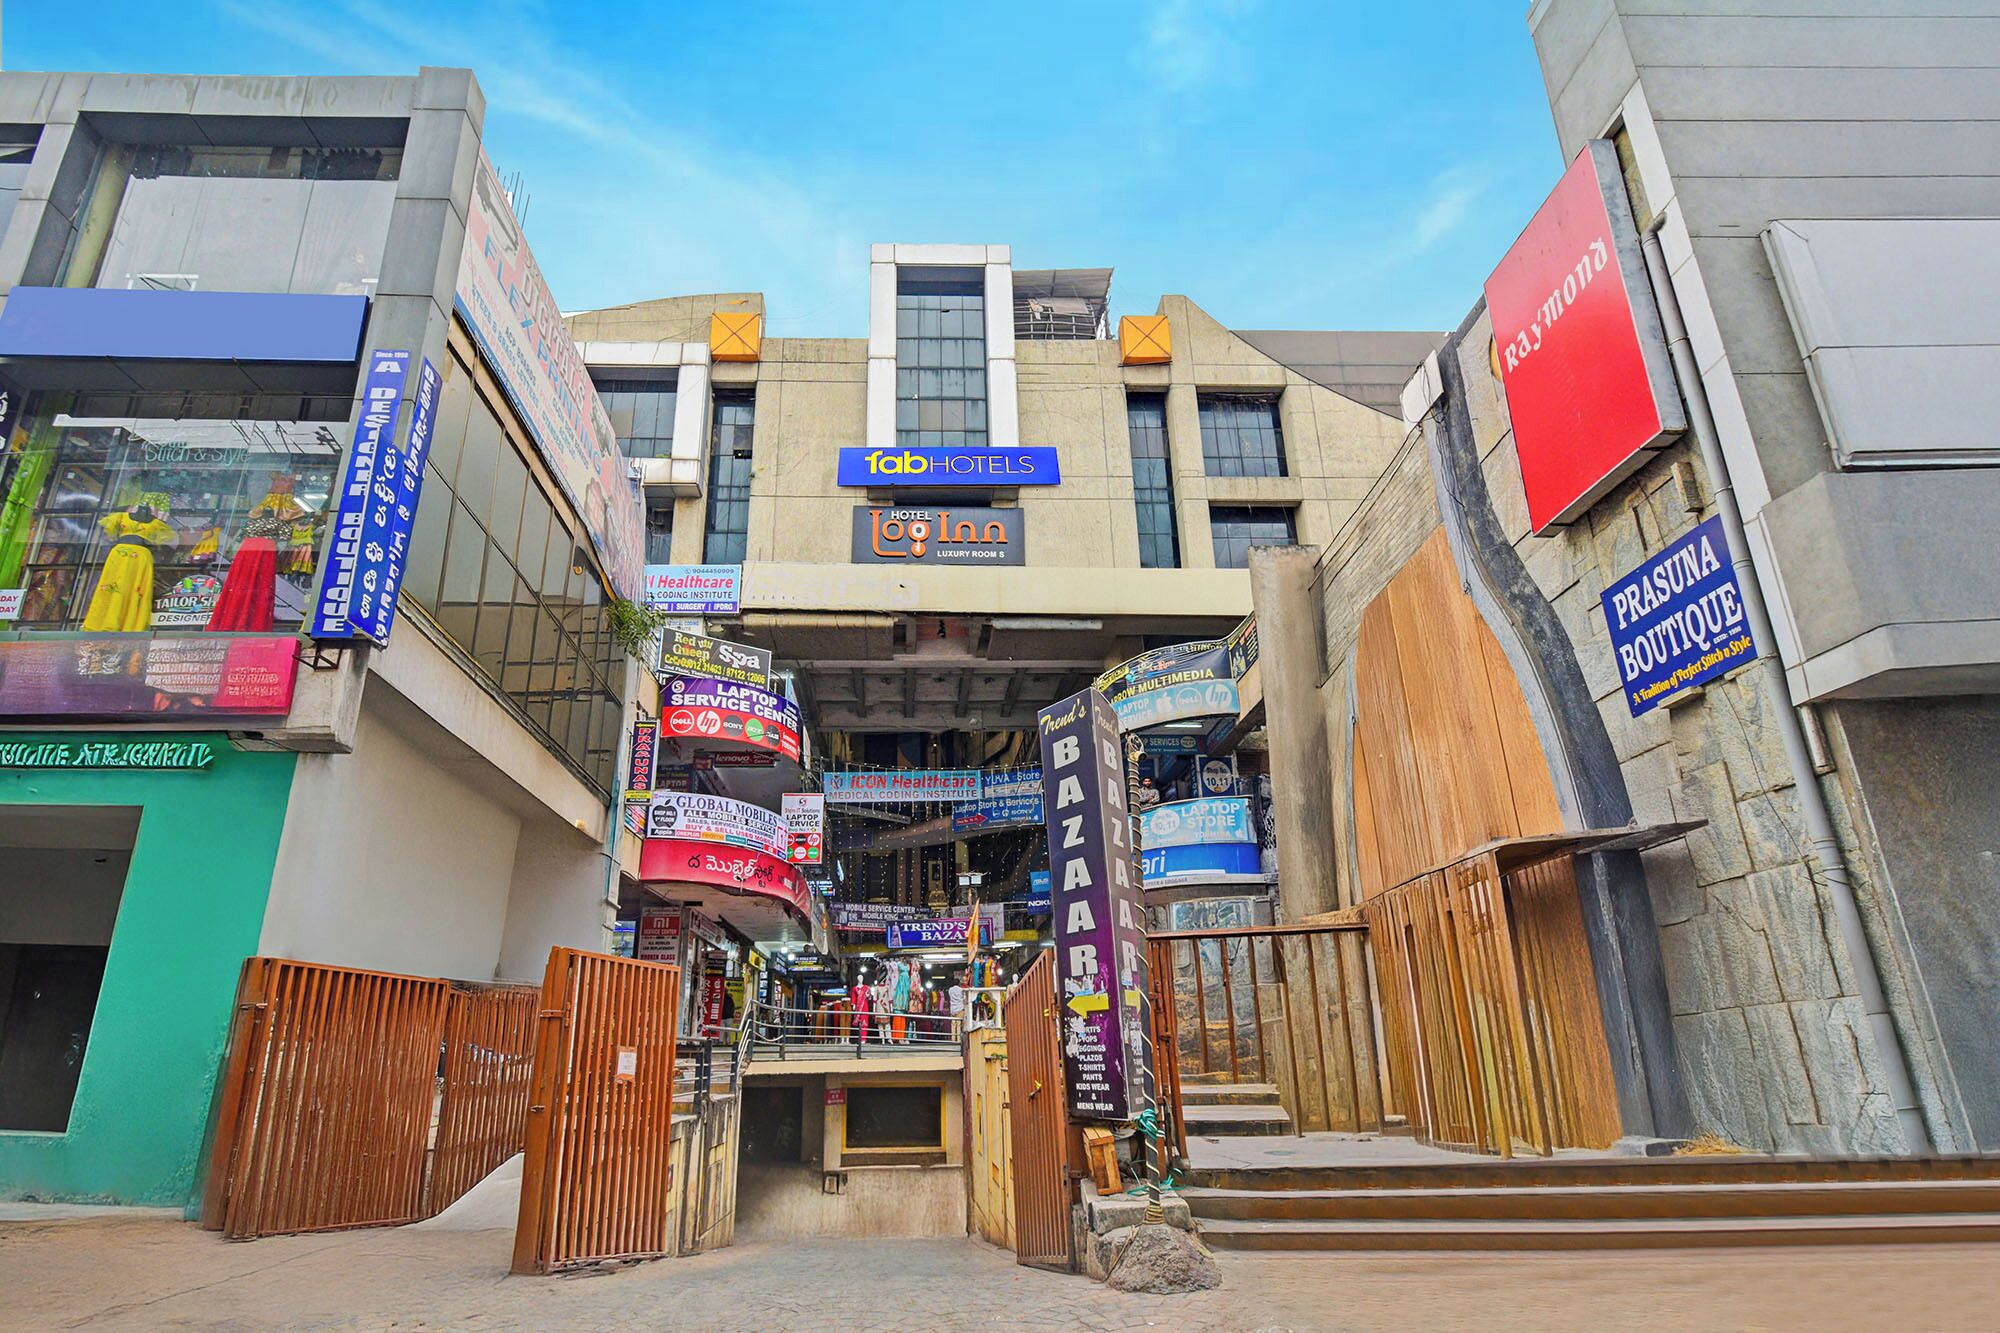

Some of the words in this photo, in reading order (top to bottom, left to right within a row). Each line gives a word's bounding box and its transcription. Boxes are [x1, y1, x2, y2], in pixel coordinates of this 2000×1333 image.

[482, 233, 535, 343] FLEX
[537, 340, 602, 475] PRINTING
[375, 361, 401, 373] A
[891, 510, 932, 520] HOTEL
[937, 550, 970, 558] LUXURY
[322, 512, 362, 632] BOUTIQUE
[657, 575, 733, 589] Healthcare
[1612, 535, 1721, 630] PRASUNA
[657, 591, 688, 599] CODING
[691, 591, 733, 599] INSTITUTE
[674, 632, 696, 646] Red
[1619, 582, 1743, 682] BOUTIQUE
[673, 643, 710, 660] Queen
[719, 644, 760, 670] Spa
[1138, 668, 1215, 693] MULTIMEDIA
[1640, 679, 1671, 700] Tradition
[1678, 659, 1702, 686] Perfect
[717, 683, 778, 708] LAPTOP
[1118, 698, 1149, 714] LAPTOP
[671, 694, 751, 713] SERVICE
[754, 704, 797, 733] CENTER
[1040, 697, 1087, 737] Trend's
[1150, 738, 1179, 746] SERVICES
[850, 775, 888, 789] ICON
[892, 774, 976, 789] Healthcare
[985, 773, 1010, 785] YUVA
[828, 790, 875, 800] MEDICAL
[878, 790, 918, 799] CODING
[922, 789, 978, 799] INSTITUTE
[676, 795, 733, 814] GLOBAL
[736, 803, 778, 827] MOBILES
[978, 800, 998, 810] Store
[1181, 802, 1241, 817] LAPTOP
[686, 810, 706, 818] ALL
[707, 812, 746, 826] MOBILES
[1187, 815, 1236, 828] STORE
[685, 823, 702, 831] BUY
[714, 827, 734, 835] SELL
[1052, 734, 1098, 977] BAZAAR
[1102, 737, 1137, 973] BAZAAR
[868, 904, 892, 913] SERVICE
[893, 905, 915, 914] CENTER
[901, 921, 967, 932] TREND'S
[1078, 1063, 1106, 1071] T-SHIRTS
[1082, 1073, 1103, 1081] PANTS
[1091, 1083, 1110, 1091] WEAR
[1076, 1102, 1094, 1110] MENS
[1095, 1103, 1114, 1111] WEAR
